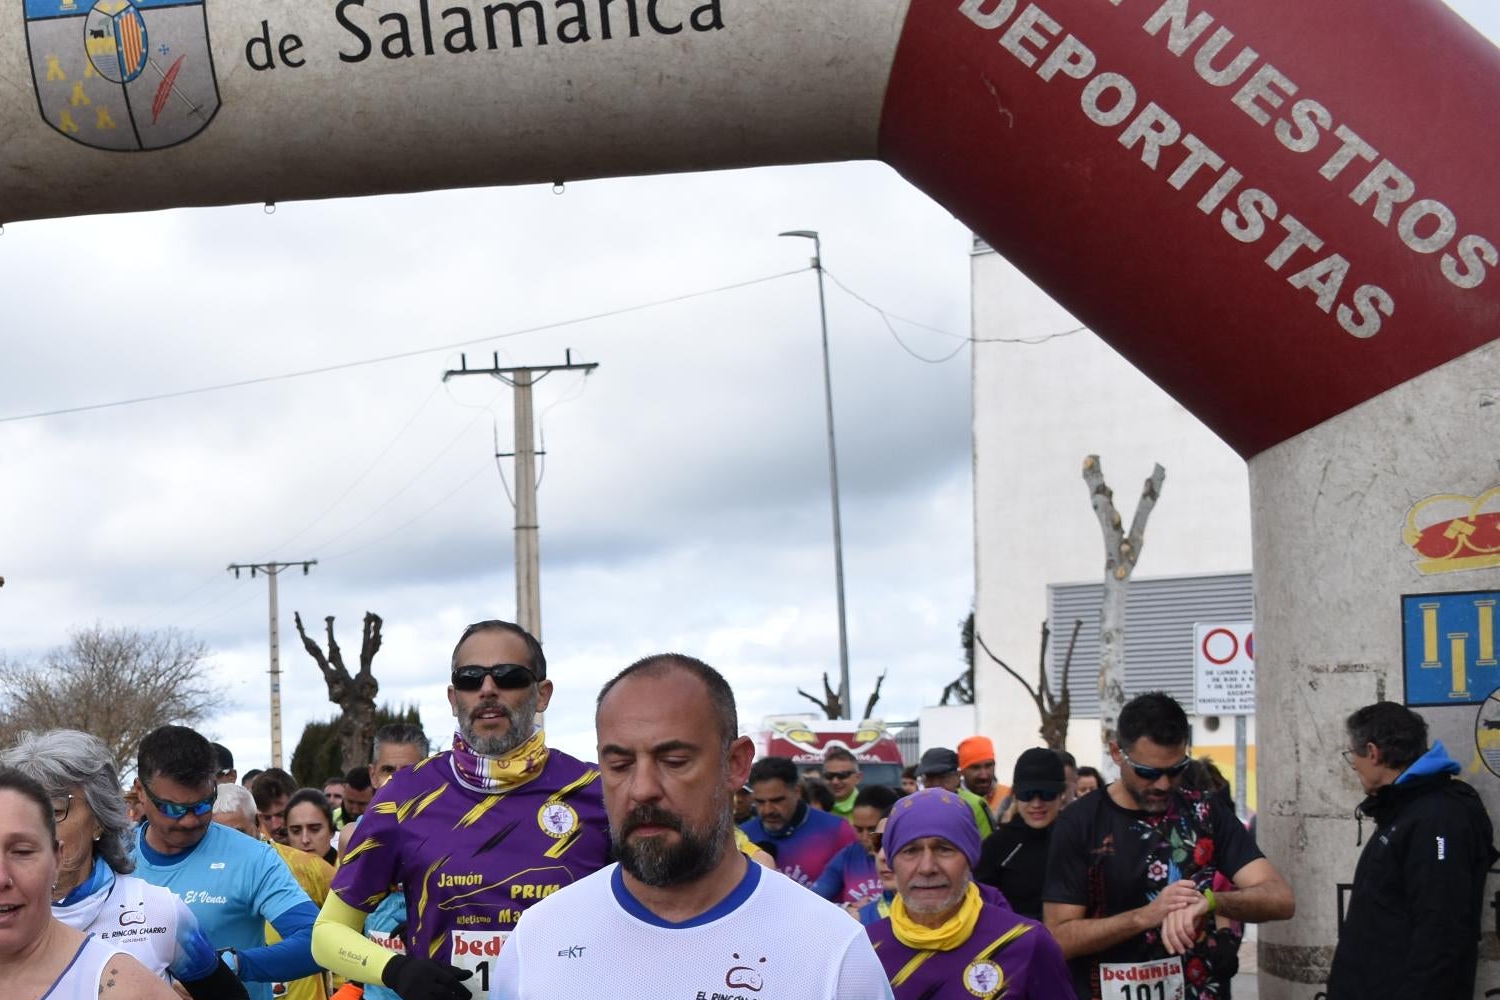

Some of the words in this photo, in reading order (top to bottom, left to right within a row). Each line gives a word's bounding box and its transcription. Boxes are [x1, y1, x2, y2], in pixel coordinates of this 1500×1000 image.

[245, 20, 306, 71] de
[334, 0, 725, 64] Salamanca
[1143, 0, 1499, 289] NUESTROS
[958, 0, 1395, 339] DEPORTISTAS
[437, 871, 483, 889] Jamón
[199, 890, 228, 905] Venas
[511, 884, 560, 899] PRIM
[101, 931, 109, 940] EL
[112, 927, 137, 939] RINCÓN
[140, 926, 167, 935] CHARRO
[1103, 962, 1181, 982] bedunia
[695, 991, 708, 1000] EL
